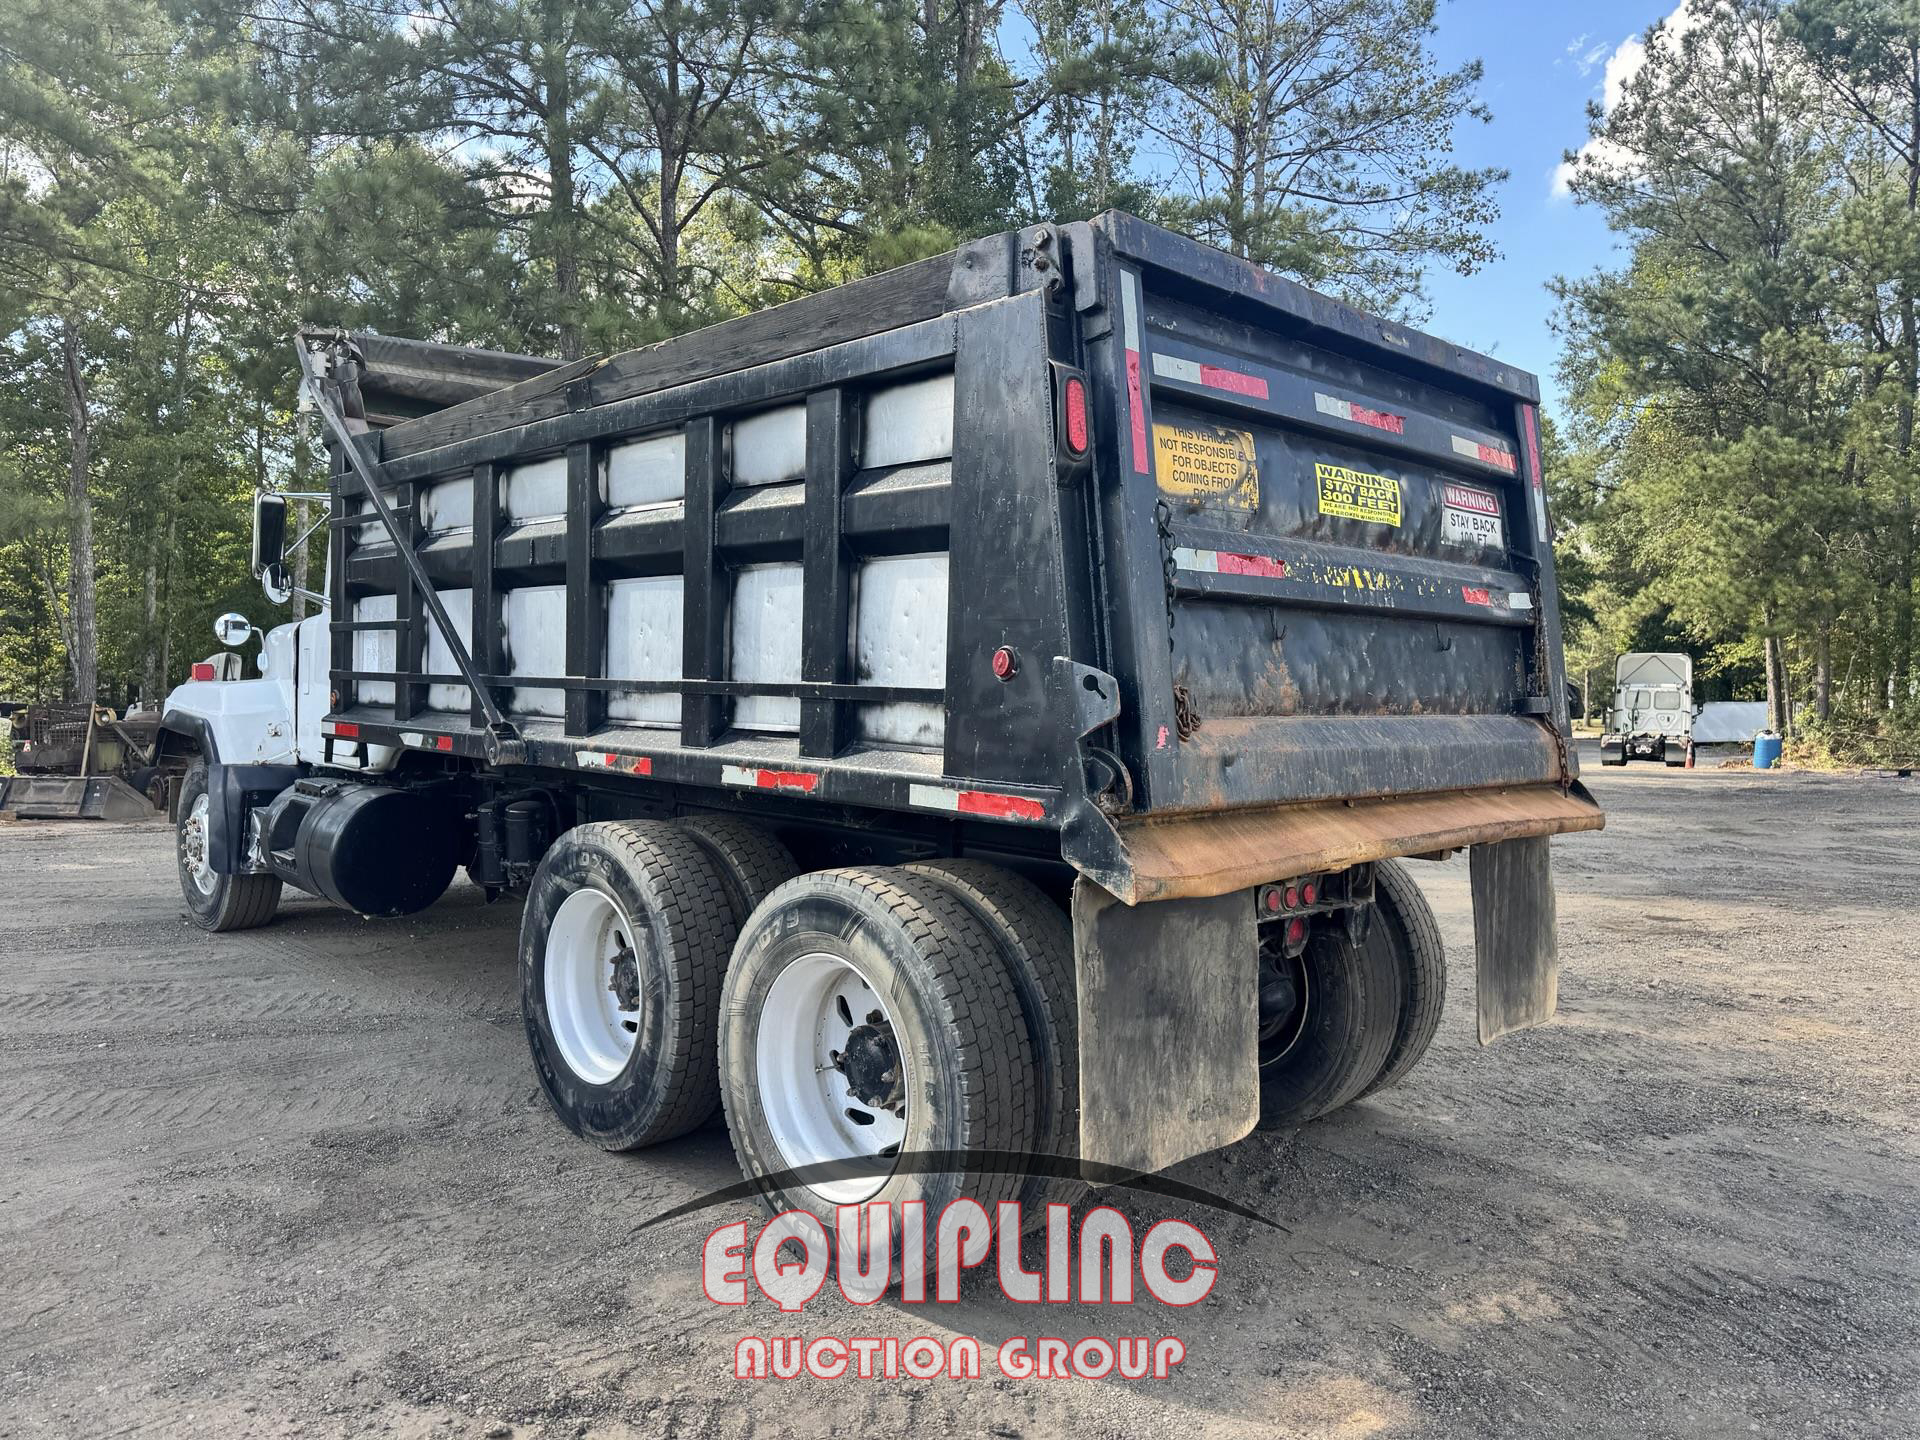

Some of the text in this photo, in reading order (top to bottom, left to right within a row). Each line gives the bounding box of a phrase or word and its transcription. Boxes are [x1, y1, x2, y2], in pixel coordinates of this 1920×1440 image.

[1160, 437, 1245, 462] NOT RESPONSIBLE
[1172, 454, 1237, 475] FOR OBJECTS
[1172, 470, 1210, 487] COMING
[1319, 465, 1397, 490] WARNING!
[1322, 490, 1397, 511] 300 FEET
[1325, 479, 1394, 502] STAY BACK
[1445, 487, 1495, 512] WARNING
[1336, 509, 1360, 519] BROKEN
[1360, 507, 1397, 519] RESPONSIBLE
[1450, 513, 1497, 534] STAY BACK
[1460, 531, 1488, 545] 100 FT
